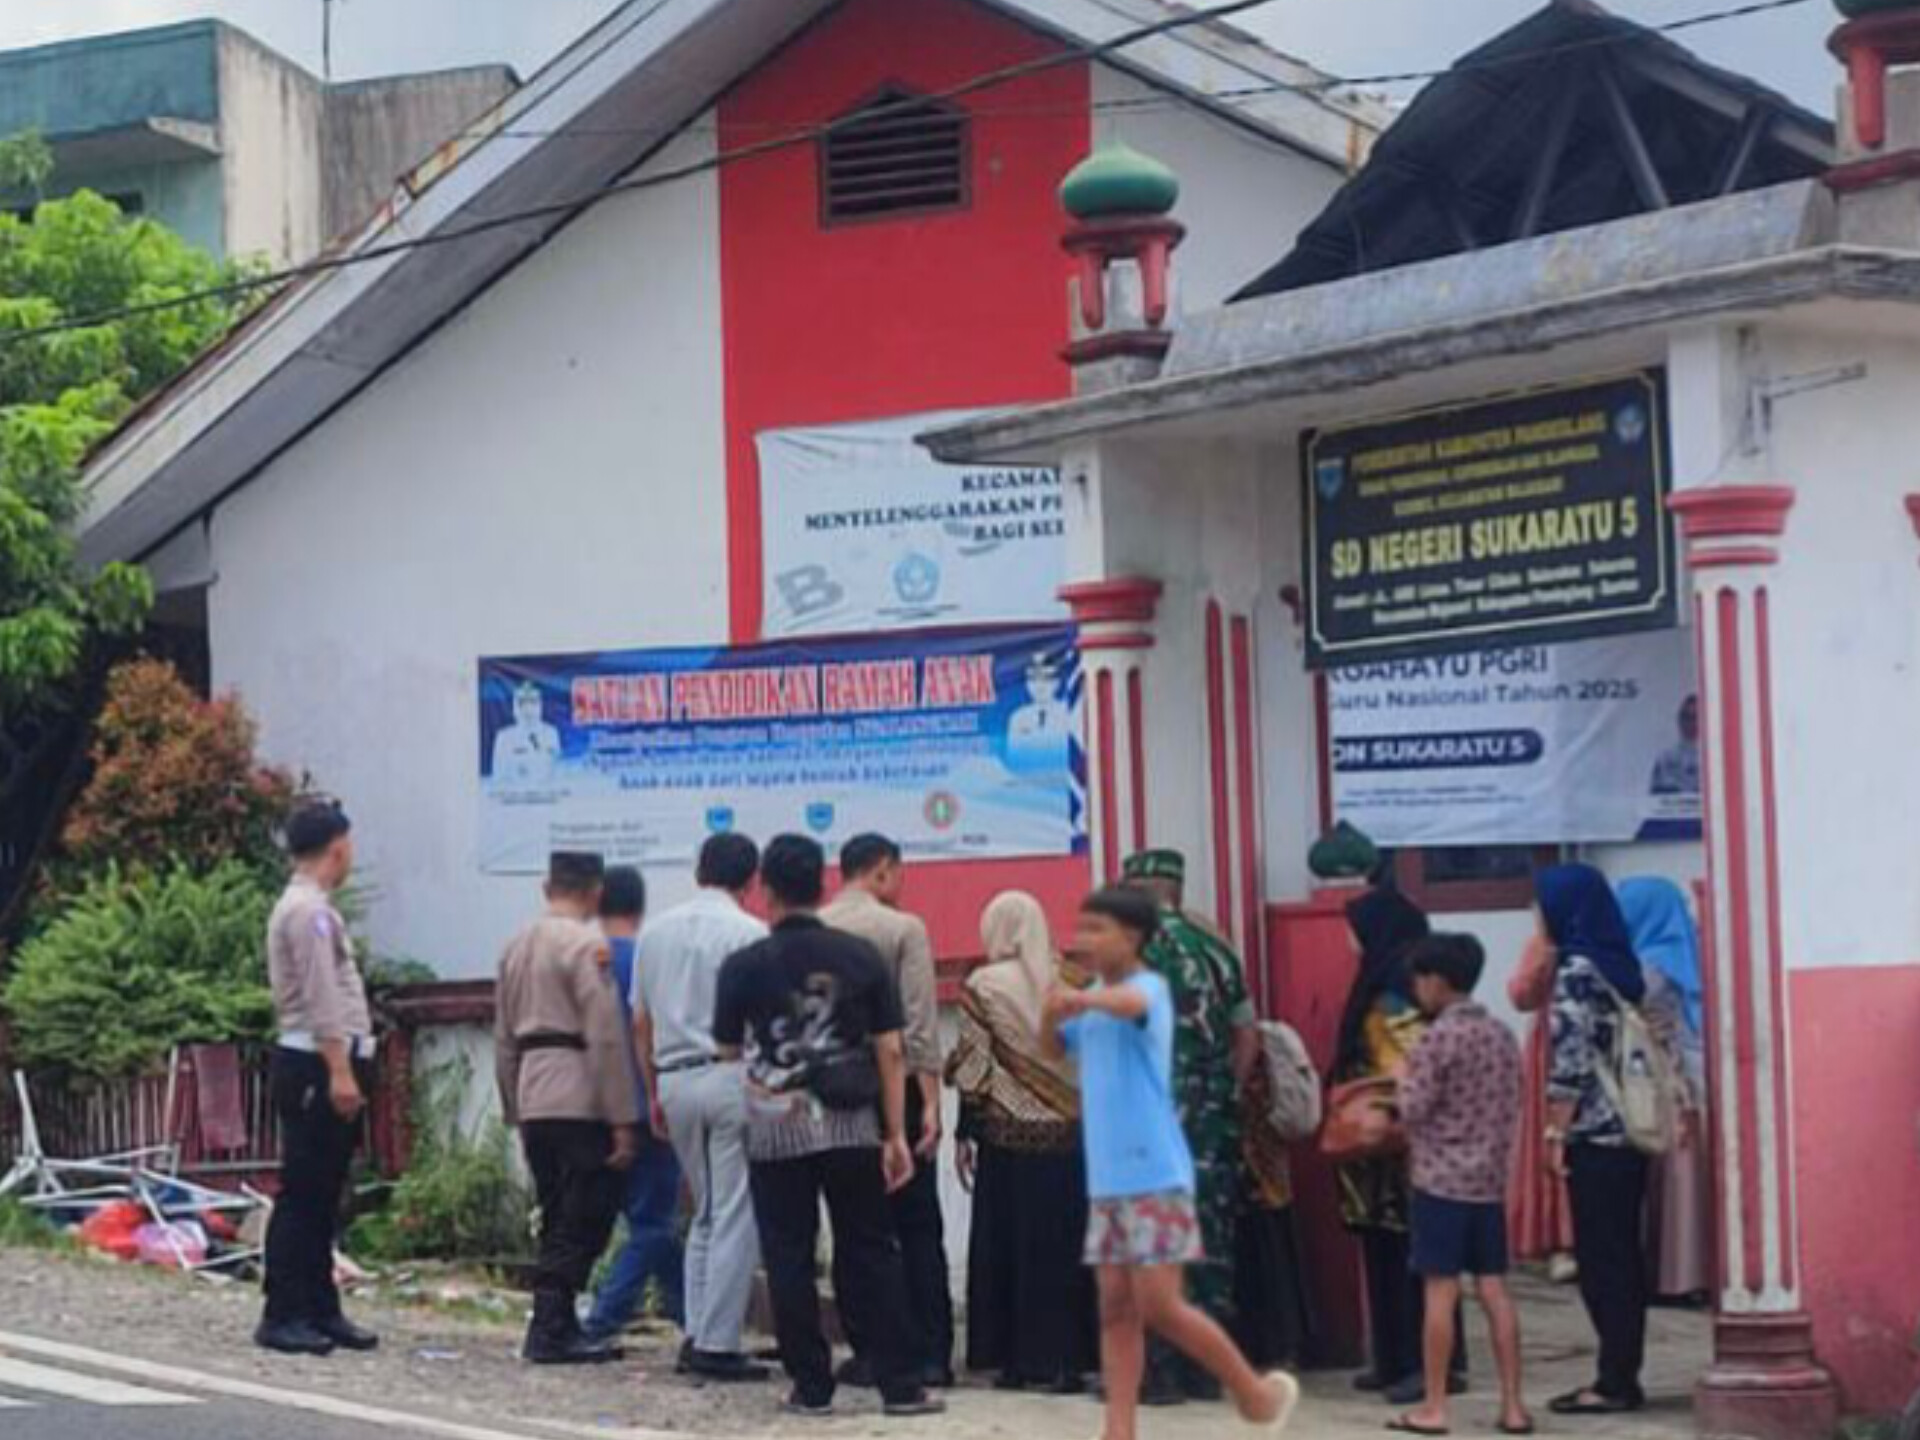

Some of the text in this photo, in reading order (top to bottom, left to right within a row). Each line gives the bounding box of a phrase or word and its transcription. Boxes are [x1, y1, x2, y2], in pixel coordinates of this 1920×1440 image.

[805, 496, 1035, 529] MENYELENGGARAKAN
[974, 521, 1025, 541] BAGI
[1331, 497, 1639, 578] SD NEGERI SUKARATU 5
[1478, 647, 1549, 676] PGRI
[670, 665, 818, 721] PENDIDIKAN
[822, 658, 915, 714] RAMAH
[922, 653, 996, 708] ANAK
[1387, 686, 1489, 708] Nasional
[1495, 683, 1571, 704] Tahun
[1577, 679, 1640, 701] 2025
[1372, 735, 1503, 763] SUKARATU
[1508, 737, 1527, 756] 5
